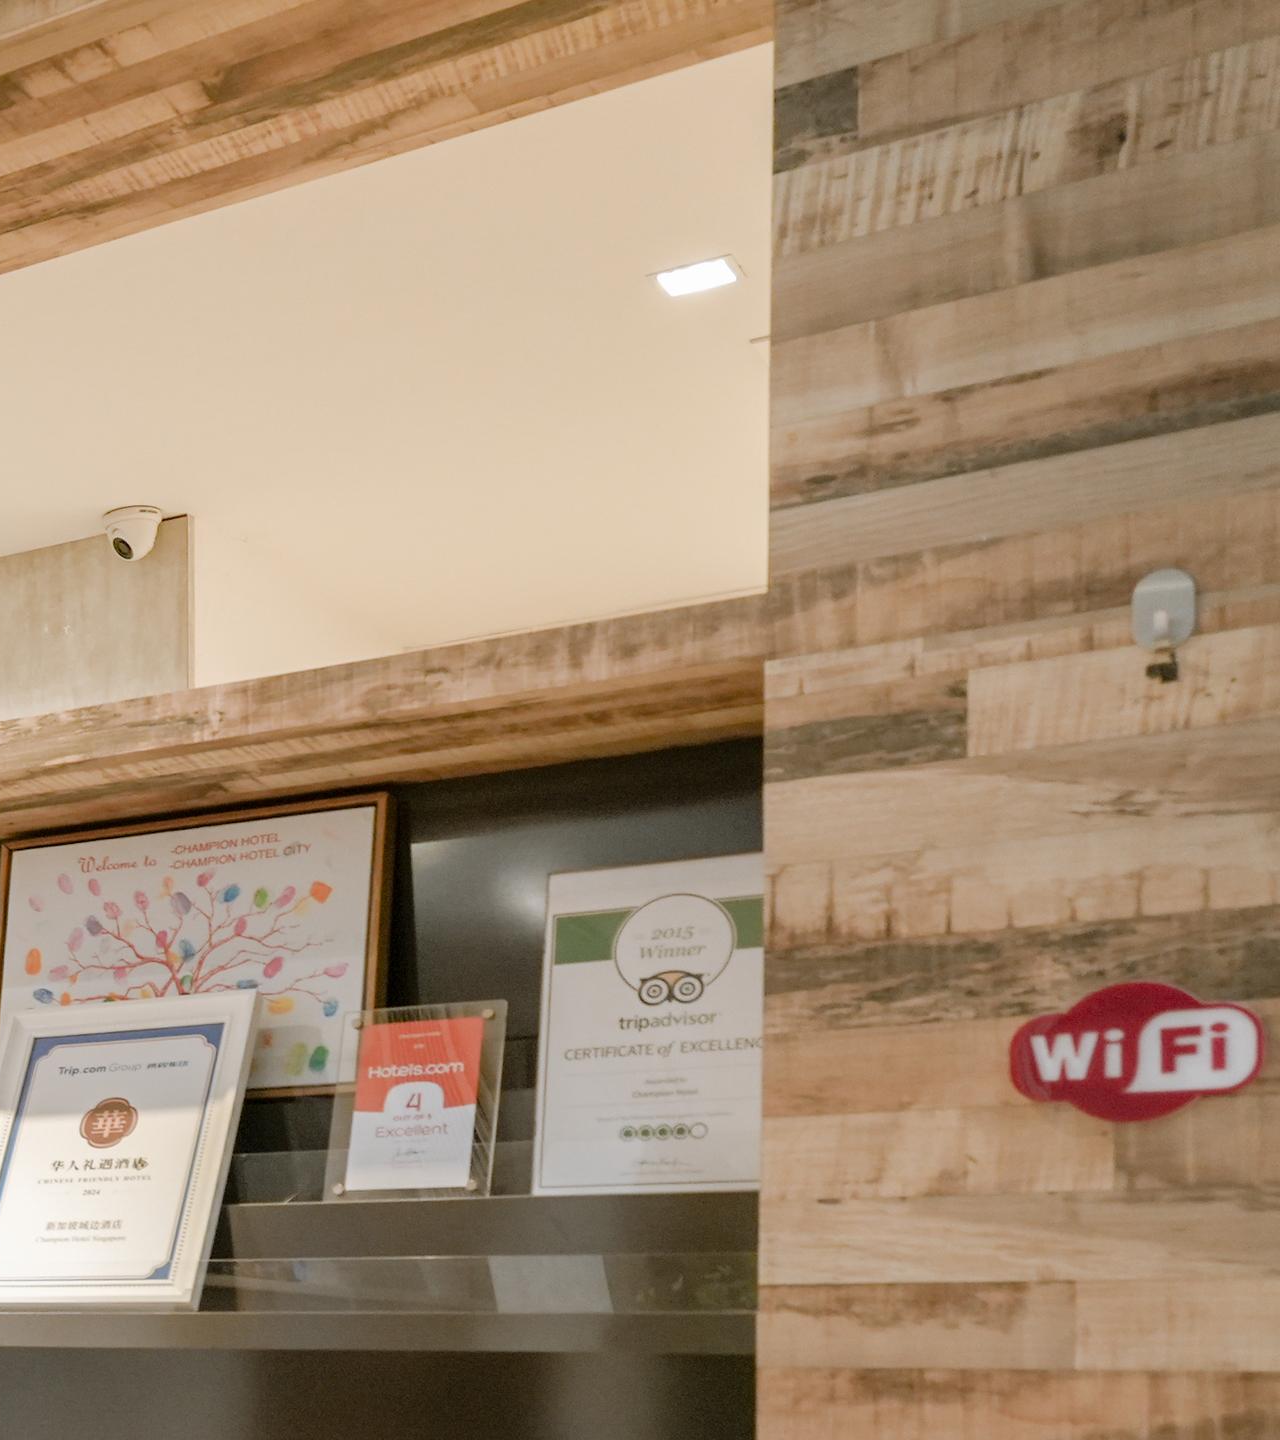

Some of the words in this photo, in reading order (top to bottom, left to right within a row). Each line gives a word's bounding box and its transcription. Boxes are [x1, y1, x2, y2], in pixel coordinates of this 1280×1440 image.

[240, 832, 281, 846] HOTEL
[239, 848, 279, 862] HOTEL
[282, 843, 312, 857] CITY
[78, 855, 138, 874] Welcome
[143, 856, 157, 867] to
[650, 926, 696, 941] 2015
[638, 943, 707, 960] Winner
[618, 1010, 718, 1032] tripadvisor
[564, 1044, 654, 1062] CERTIFICATE
[657, 1040, 676, 1058] of
[58, 1065, 107, 1078] Trip.com
[109, 1062, 143, 1074] Group
[367, 1061, 465, 1080] Hotels.com
[405, 1093, 422, 1111] 4
[375, 1122, 450, 1138] Excellent
